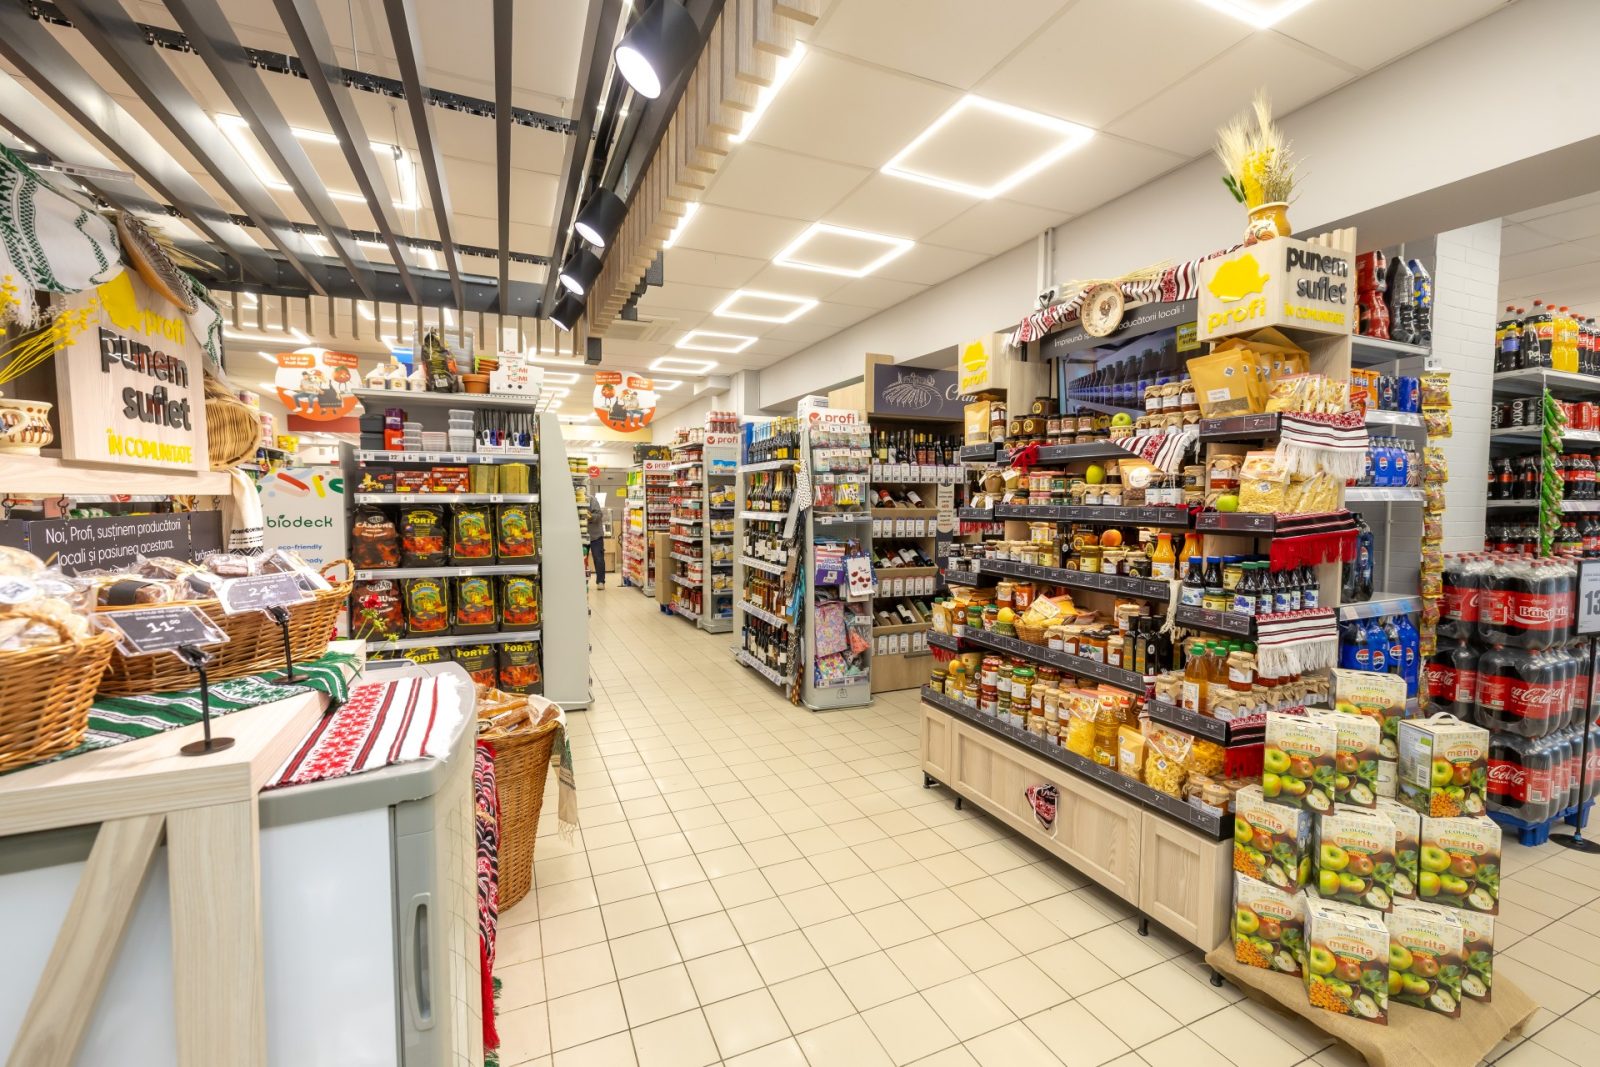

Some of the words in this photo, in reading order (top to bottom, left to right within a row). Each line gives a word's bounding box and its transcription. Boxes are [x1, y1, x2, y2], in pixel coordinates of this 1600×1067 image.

[1286, 247, 1348, 278] punem
[1296, 276, 1348, 305] suflet
[1207, 297, 1266, 334] profi
[145, 308, 185, 346] profi
[1054, 334, 1082, 348] Împreună
[1119, 314, 1156, 330] oducătorii
[1158, 306, 1180, 319] locali
[98, 326, 188, 388] punem
[962, 370, 987, 391] profi
[122, 385, 192, 431] suflet
[824, 413, 855, 424] profi
[106, 428, 122, 457] ÎN
[124, 436, 192, 464] COMUNITATE
[718, 436, 738, 444] profi
[266, 515, 332, 528] biodeck
[46, 528, 68, 544] Noi,
[70, 525, 95, 541] Profi,
[97, 523, 136, 540] susținem
[138, 518, 180, 536] producătorii
[56, 548, 86, 566] locali
[88, 547, 96, 565] și
[98, 544, 139, 564] pasiunea
[141, 539, 174, 553] acestora.
[457, 649, 489, 657] FORTE
[504, 643, 533, 652] FORTE
[1351, 694, 1391, 705] merita
[1280, 740, 1320, 753] merita
[1448, 748, 1479, 757] merita
[1247, 812, 1282, 831] merita
[1337, 837, 1378, 849] merita
[1440, 837, 1484, 851] merita
[1253, 902, 1292, 916] merita
[1329, 939, 1373, 956] merita
[1401, 935, 1446, 951] merita
